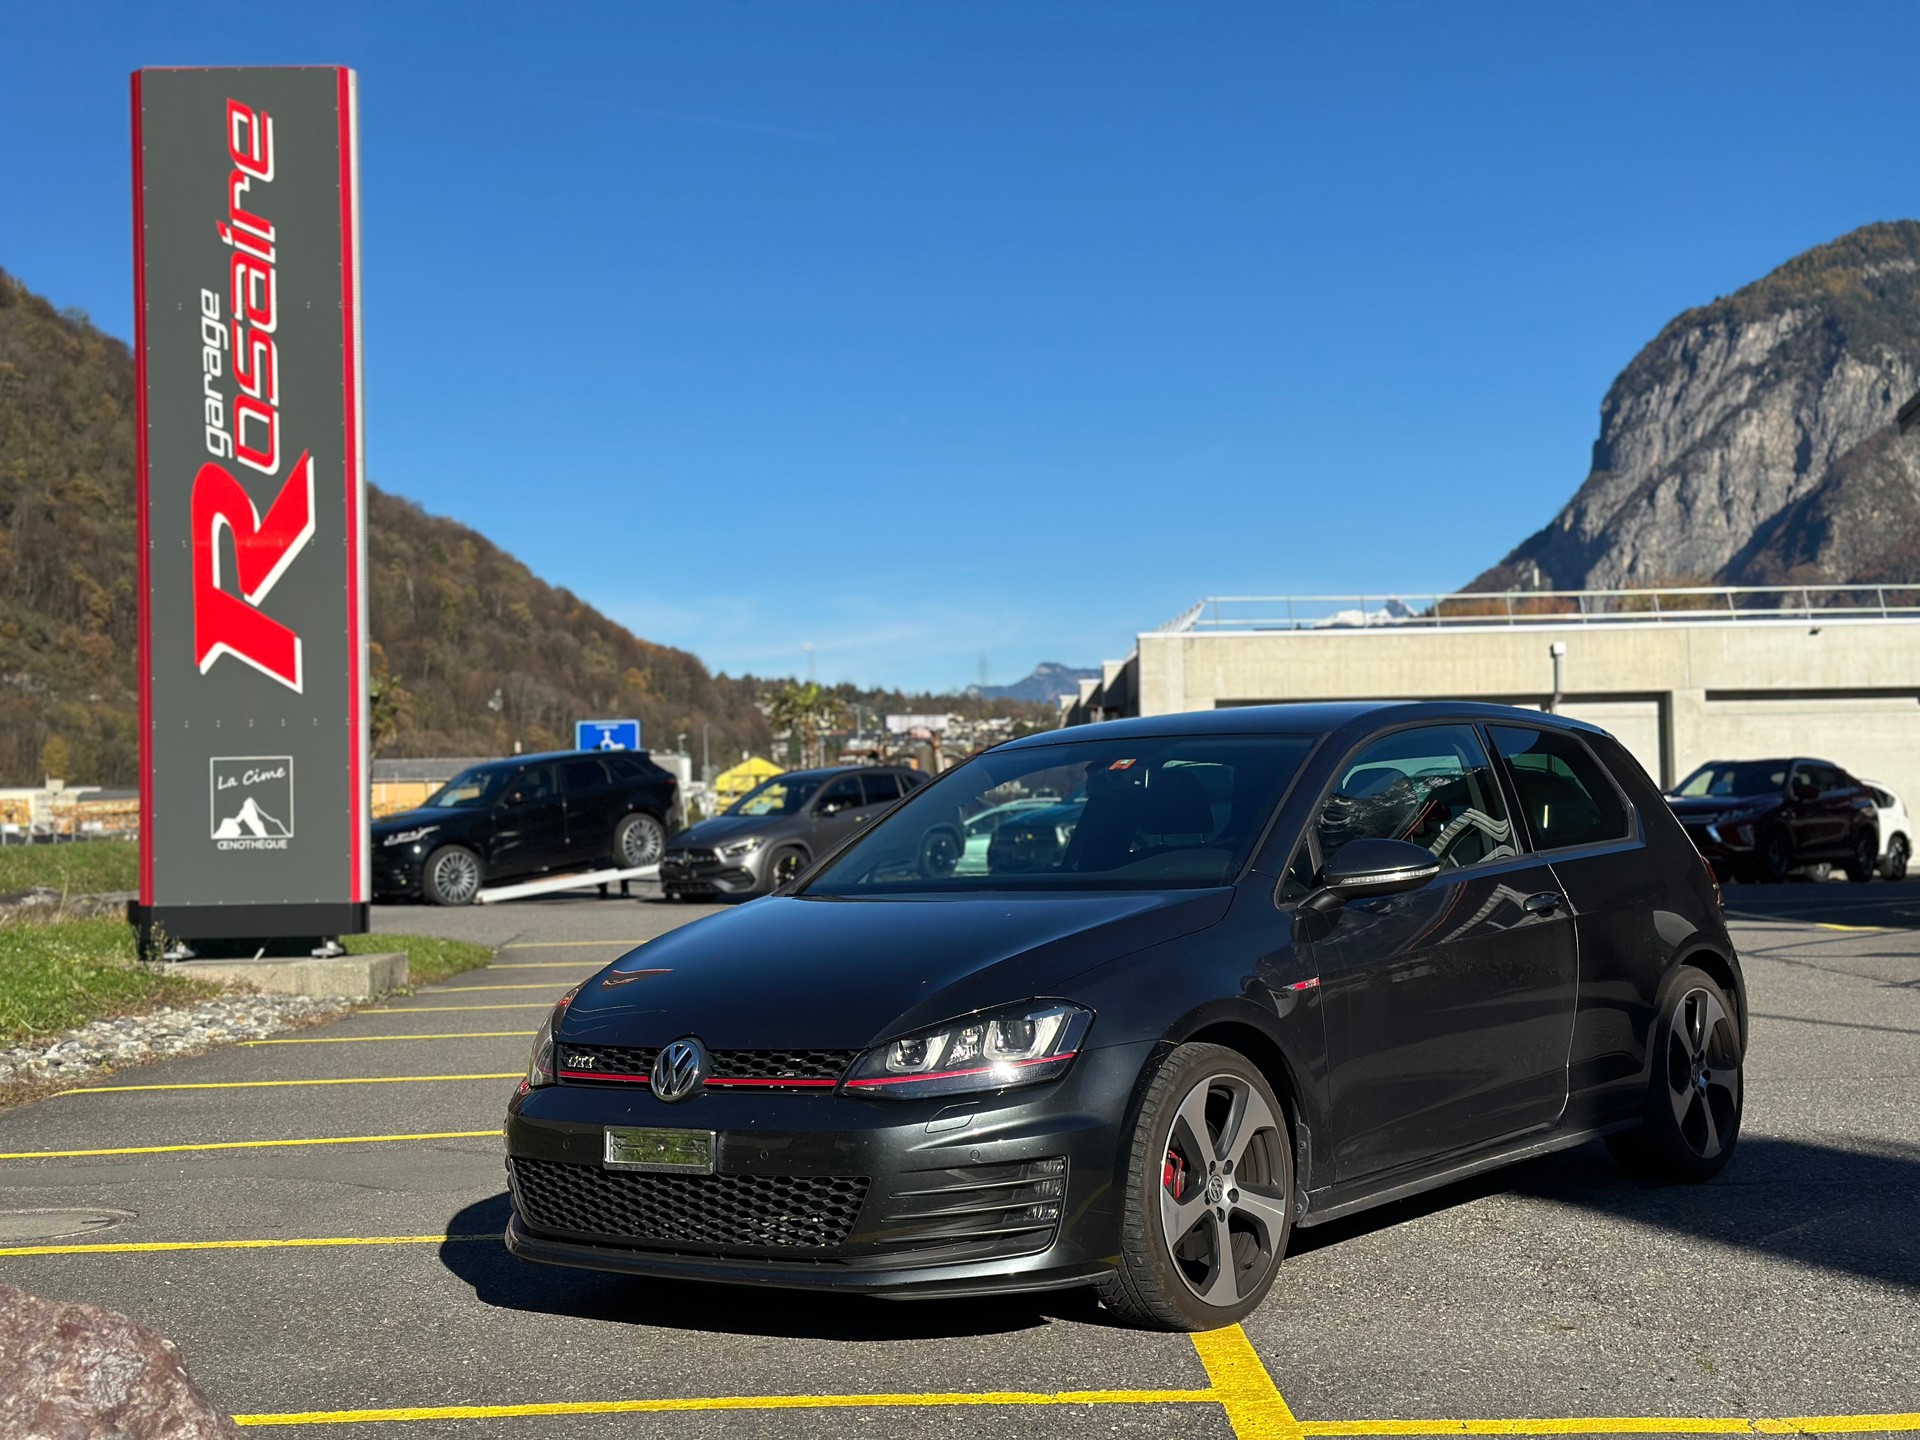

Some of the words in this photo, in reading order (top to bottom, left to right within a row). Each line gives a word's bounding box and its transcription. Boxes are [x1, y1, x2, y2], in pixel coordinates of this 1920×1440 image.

[201, 288, 233, 459] garage
[217, 775, 238, 790] La
[242, 767, 286, 785] Cime
